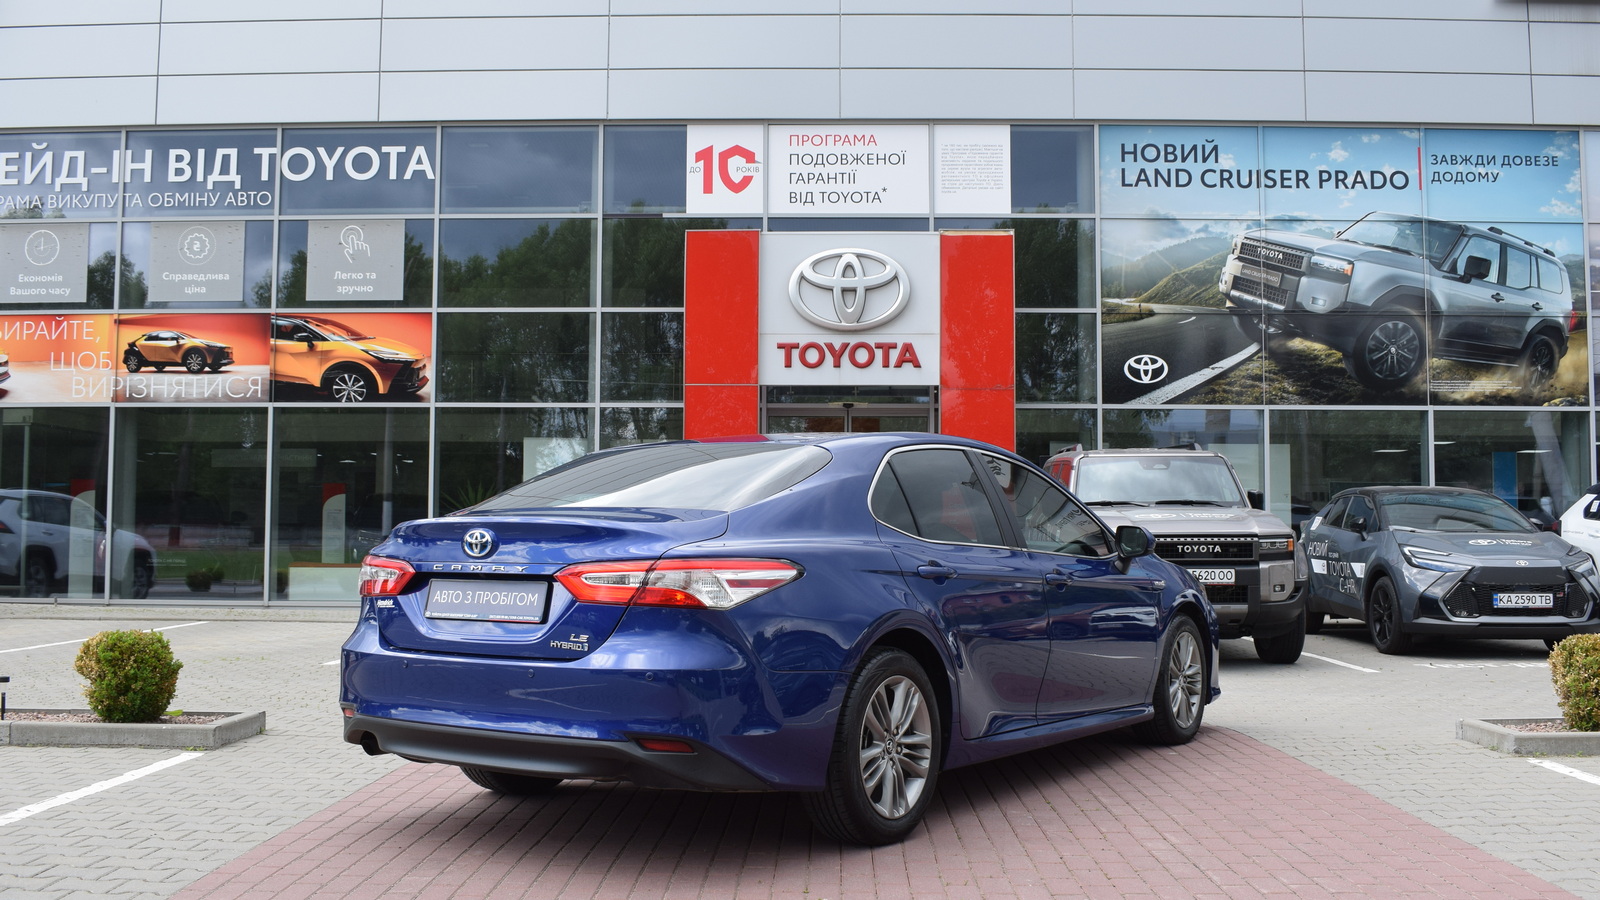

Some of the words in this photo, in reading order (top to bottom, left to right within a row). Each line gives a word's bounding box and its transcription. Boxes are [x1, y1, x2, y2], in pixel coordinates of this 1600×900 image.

[790, 134, 878, 146] ПРОГРАМА
[1121, 139, 1219, 163] НОВИЙ
[790, 150, 907, 168] ПОДОВЖЕНОЇ
[1430, 154, 1496, 168] ЗАВЖДИ
[1501, 156, 1558, 168] ДОВЕЗЕ
[168, 148, 241, 190] ВІД
[253, 145, 435, 182] TOYOTA
[689, 166, 702, 174] ДО
[695, 144, 756, 194] 10
[790, 169, 857, 184] ГАРАНТІЇ
[1121, 168, 1193, 188] LAND
[1200, 168, 1310, 189] CRUISER
[1318, 170, 1410, 190] PRADO
[1431, 172, 1500, 184] ДОДОМУ
[48, 193, 118, 209] ВИКУПУ
[123, 193, 143, 208] ТА
[148, 192, 222, 208] ОБМІНУ
[224, 191, 272, 206] АВТО
[790, 191, 815, 206] ВІД
[1257, 247, 1283, 260] TOYOTA
[18, 273, 63, 282] Економія
[162, 272, 230, 282] Справедлива
[334, 271, 364, 280] Легко
[366, 272, 376, 280] та
[10, 287, 46, 296] Вашого
[50, 288, 70, 296] часу
[185, 285, 206, 294] ціна
[336, 285, 374, 294] зручно
[0, 316, 100, 343] ИРАЙТЕ,
[777, 342, 922, 368] TOYOTA
[50, 351, 112, 374] ЩОБ
[72, 376, 262, 398] ВИРІЗНЯТИСЯ
[1177, 545, 1222, 553] TOYOTA
[434, 564, 529, 572] CAMRY
[1329, 561, 1352, 577] TOYOTA
[433, 590, 462, 603] АВТО
[474, 592, 538, 606] ПРОБІГОМ
[1498, 595, 1513, 604] KA
[1514, 595, 1536, 604] 2590
[1538, 595, 1552, 604] TB
[570, 634, 589, 642] LE
